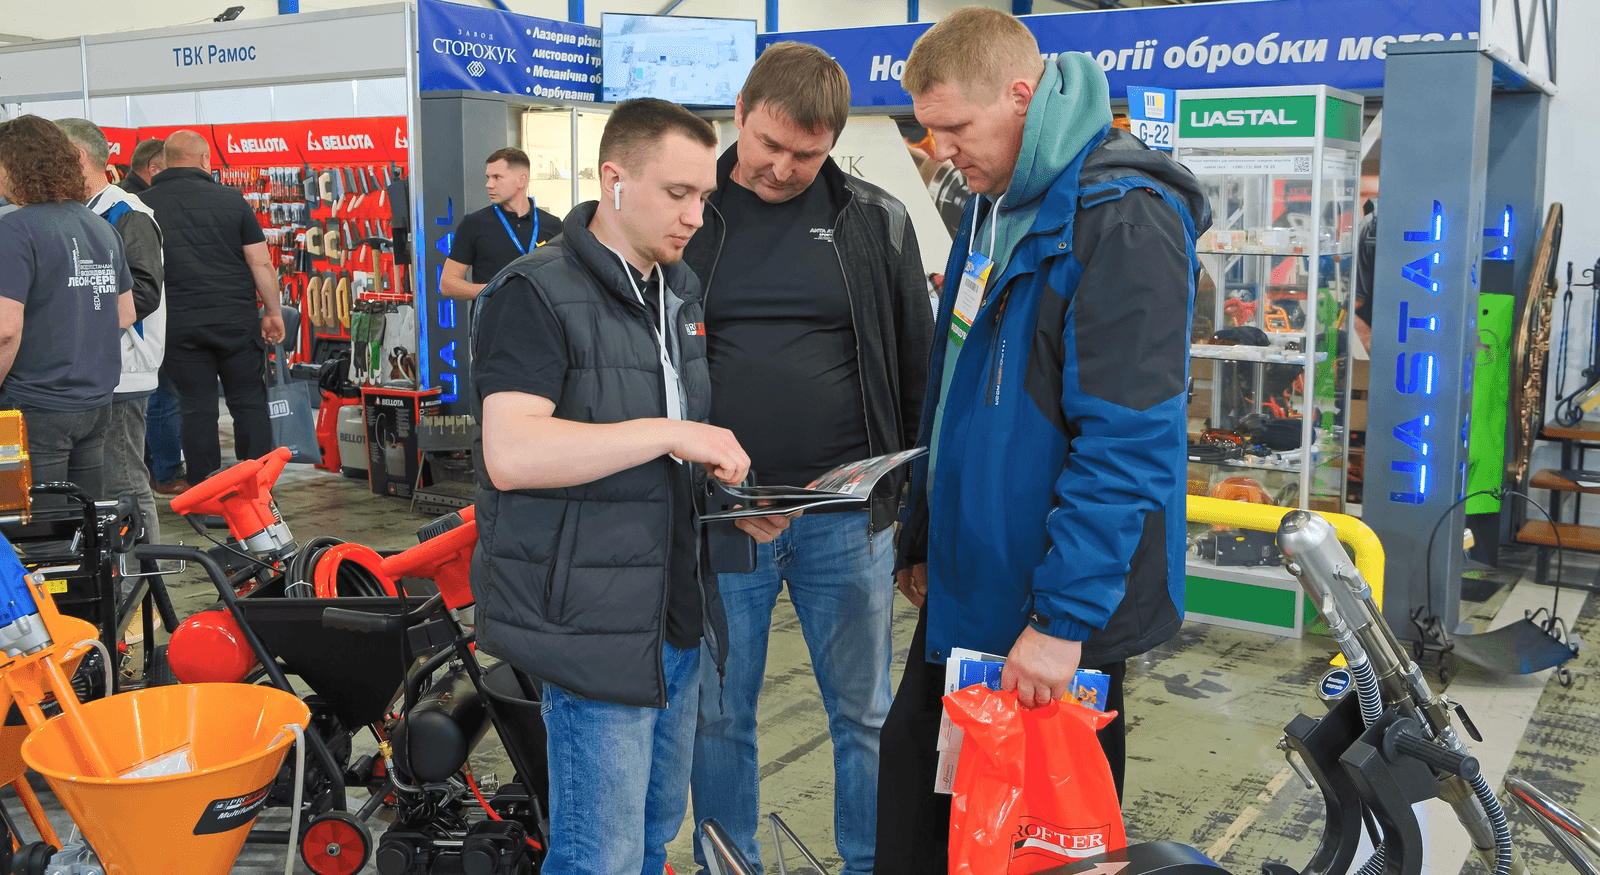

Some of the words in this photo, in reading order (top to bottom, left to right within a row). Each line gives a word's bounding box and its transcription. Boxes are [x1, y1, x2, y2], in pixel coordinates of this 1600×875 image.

[458, 29, 494, 40] ЗАВОД
[532, 26, 576, 44] Лазерна
[172, 46, 203, 67] ТВК
[208, 44, 256, 64] Рамос
[432, 38, 517, 64] СТОРОЖУК
[532, 48, 584, 64] листового
[591, 58, 601, 69] тр
[869, 54, 906, 82] Но
[1163, 32, 1328, 73] обробки
[532, 64, 588, 83] Механічна
[589, 73, 602, 84] об
[532, 83, 595, 102] Фарбування
[1190, 108, 1298, 128] UASTAL
[321, 134, 375, 150] BELLOTA
[1139, 122, 1169, 145] G-22
[240, 137, 289, 153] BELLOTA
[67, 275, 116, 288] ЛЕОН-СЕРВ
[1389, 199, 1443, 505] UASTAL
[381, 398, 404, 407] BELLOTA
[340, 432, 366, 445] BELLOT
